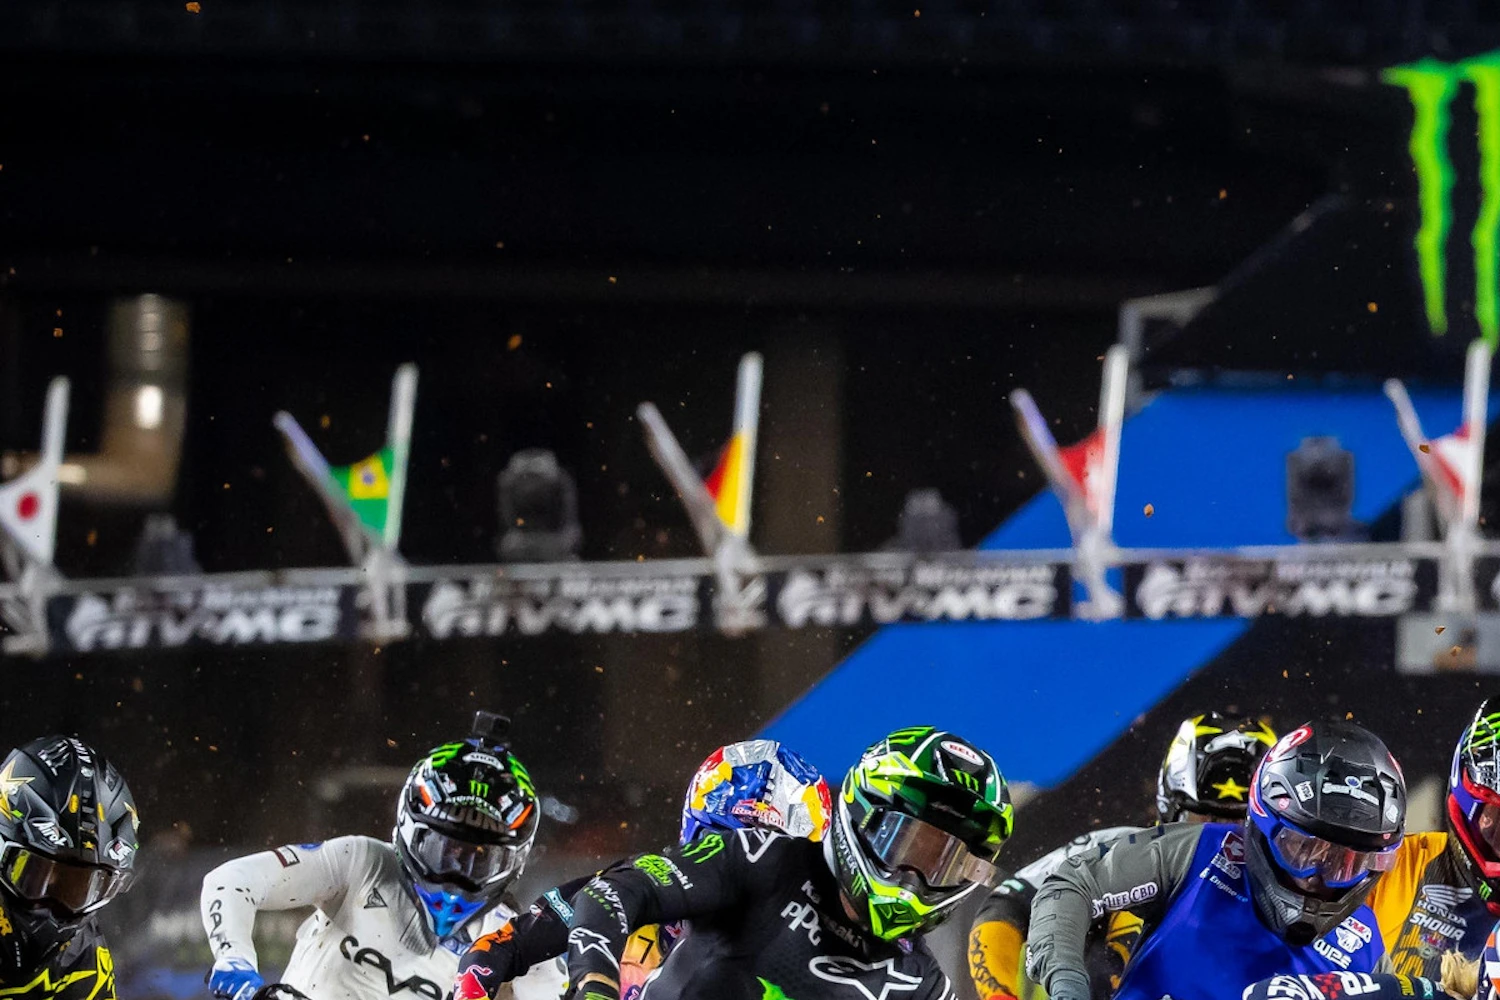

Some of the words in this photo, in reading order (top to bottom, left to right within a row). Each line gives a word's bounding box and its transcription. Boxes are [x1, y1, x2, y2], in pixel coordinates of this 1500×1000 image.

[1132, 884, 1157, 901] CBD
[1409, 912, 1467, 941] SHOWA
[1416, 900, 1468, 928] HONDA
